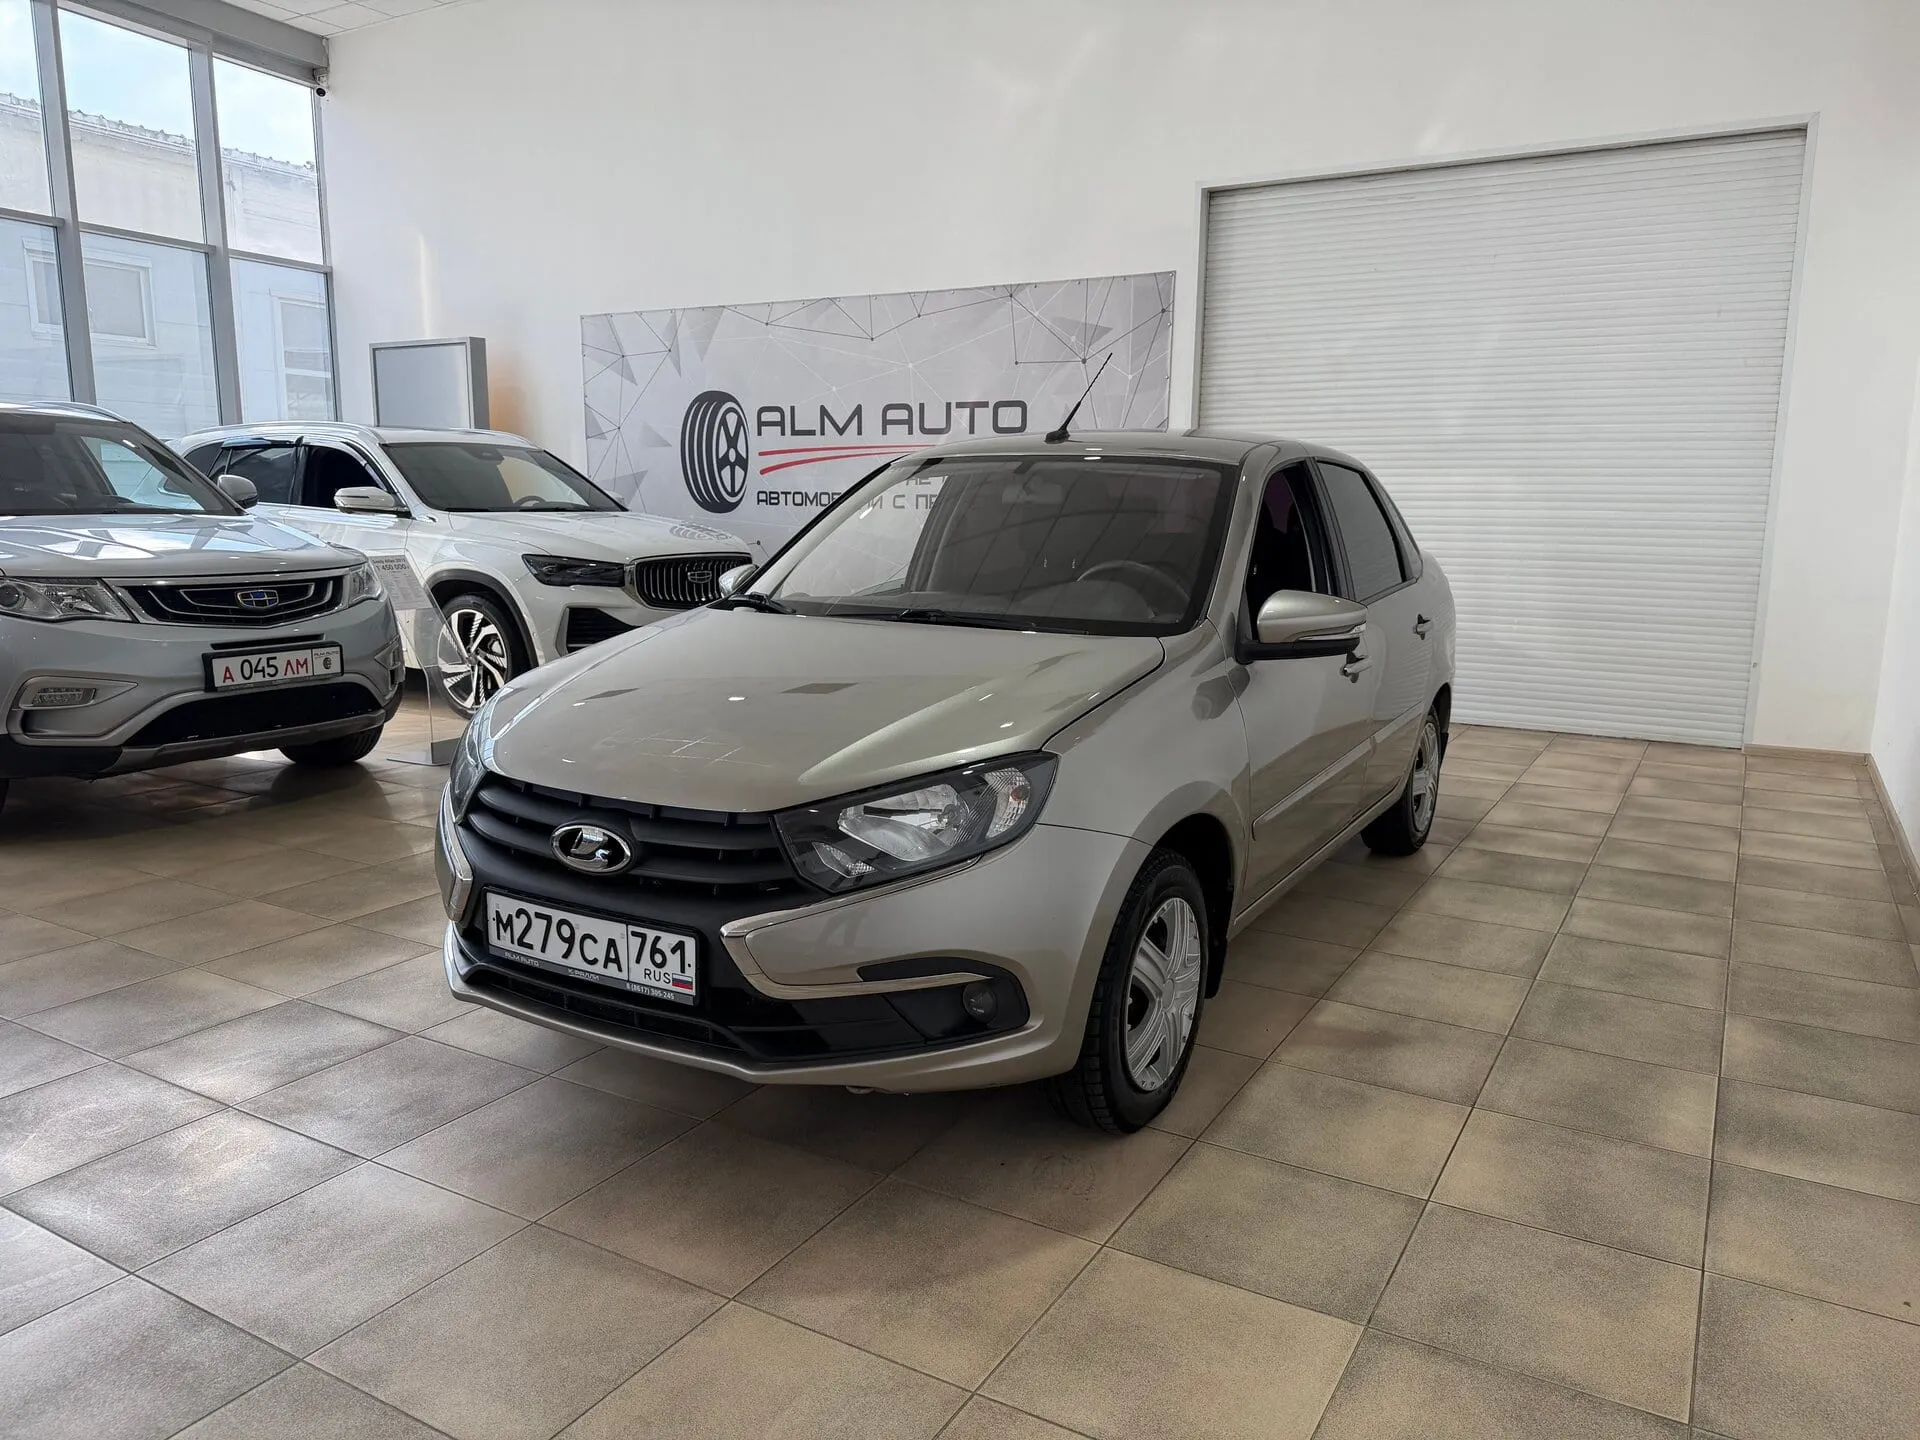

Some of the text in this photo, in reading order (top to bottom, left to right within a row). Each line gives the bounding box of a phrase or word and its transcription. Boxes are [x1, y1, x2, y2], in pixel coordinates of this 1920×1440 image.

[757, 400, 1028, 437] ALM AUTO
[240, 656, 279, 680] 045
[284, 658, 309, 676] ЛМ
[630, 931, 686, 974] 761
[644, 968, 671, 984] RUS
